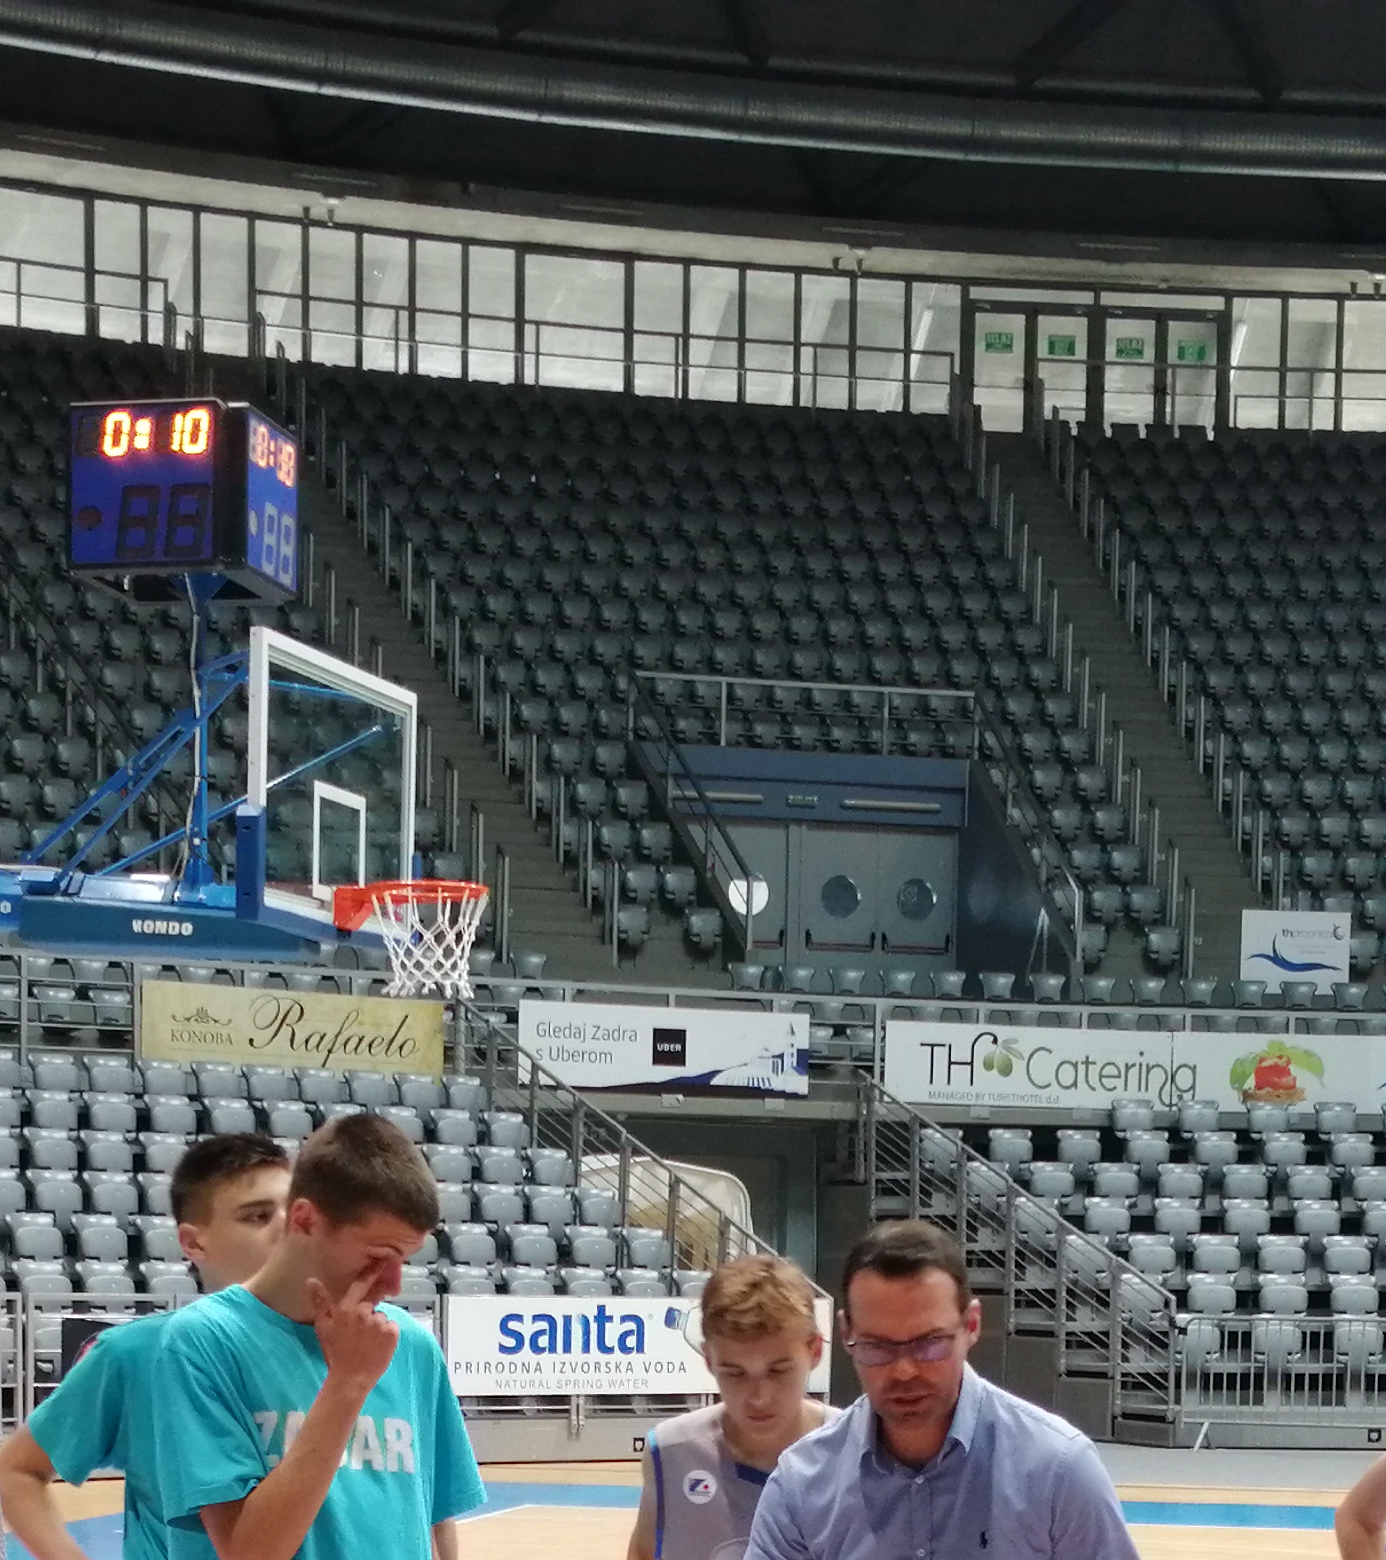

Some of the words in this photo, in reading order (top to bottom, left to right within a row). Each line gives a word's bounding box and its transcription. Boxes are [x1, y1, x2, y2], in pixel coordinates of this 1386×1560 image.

[102, 408, 210, 458] 0:10
[169, 1028, 234, 1047] KONOBA
[248, 994, 421, 1068] Rafaelo
[535, 1020, 588, 1042] Gledaj
[591, 1024, 639, 1044] Zadra
[547, 1044, 614, 1065] Uberom
[1026, 1046, 1198, 1110] Catering
[498, 1303, 646, 1356] santa
[453, 1360, 544, 1376] PRIRODNA
[553, 1360, 634, 1376] IZVORSKA
[643, 1360, 688, 1375] VODA
[494, 1378, 552, 1391] NATURAL
[556, 1379, 604, 1391] SPRING
[607, 1378, 650, 1391] WATER
[254, 1410, 415, 1474] ZAR
